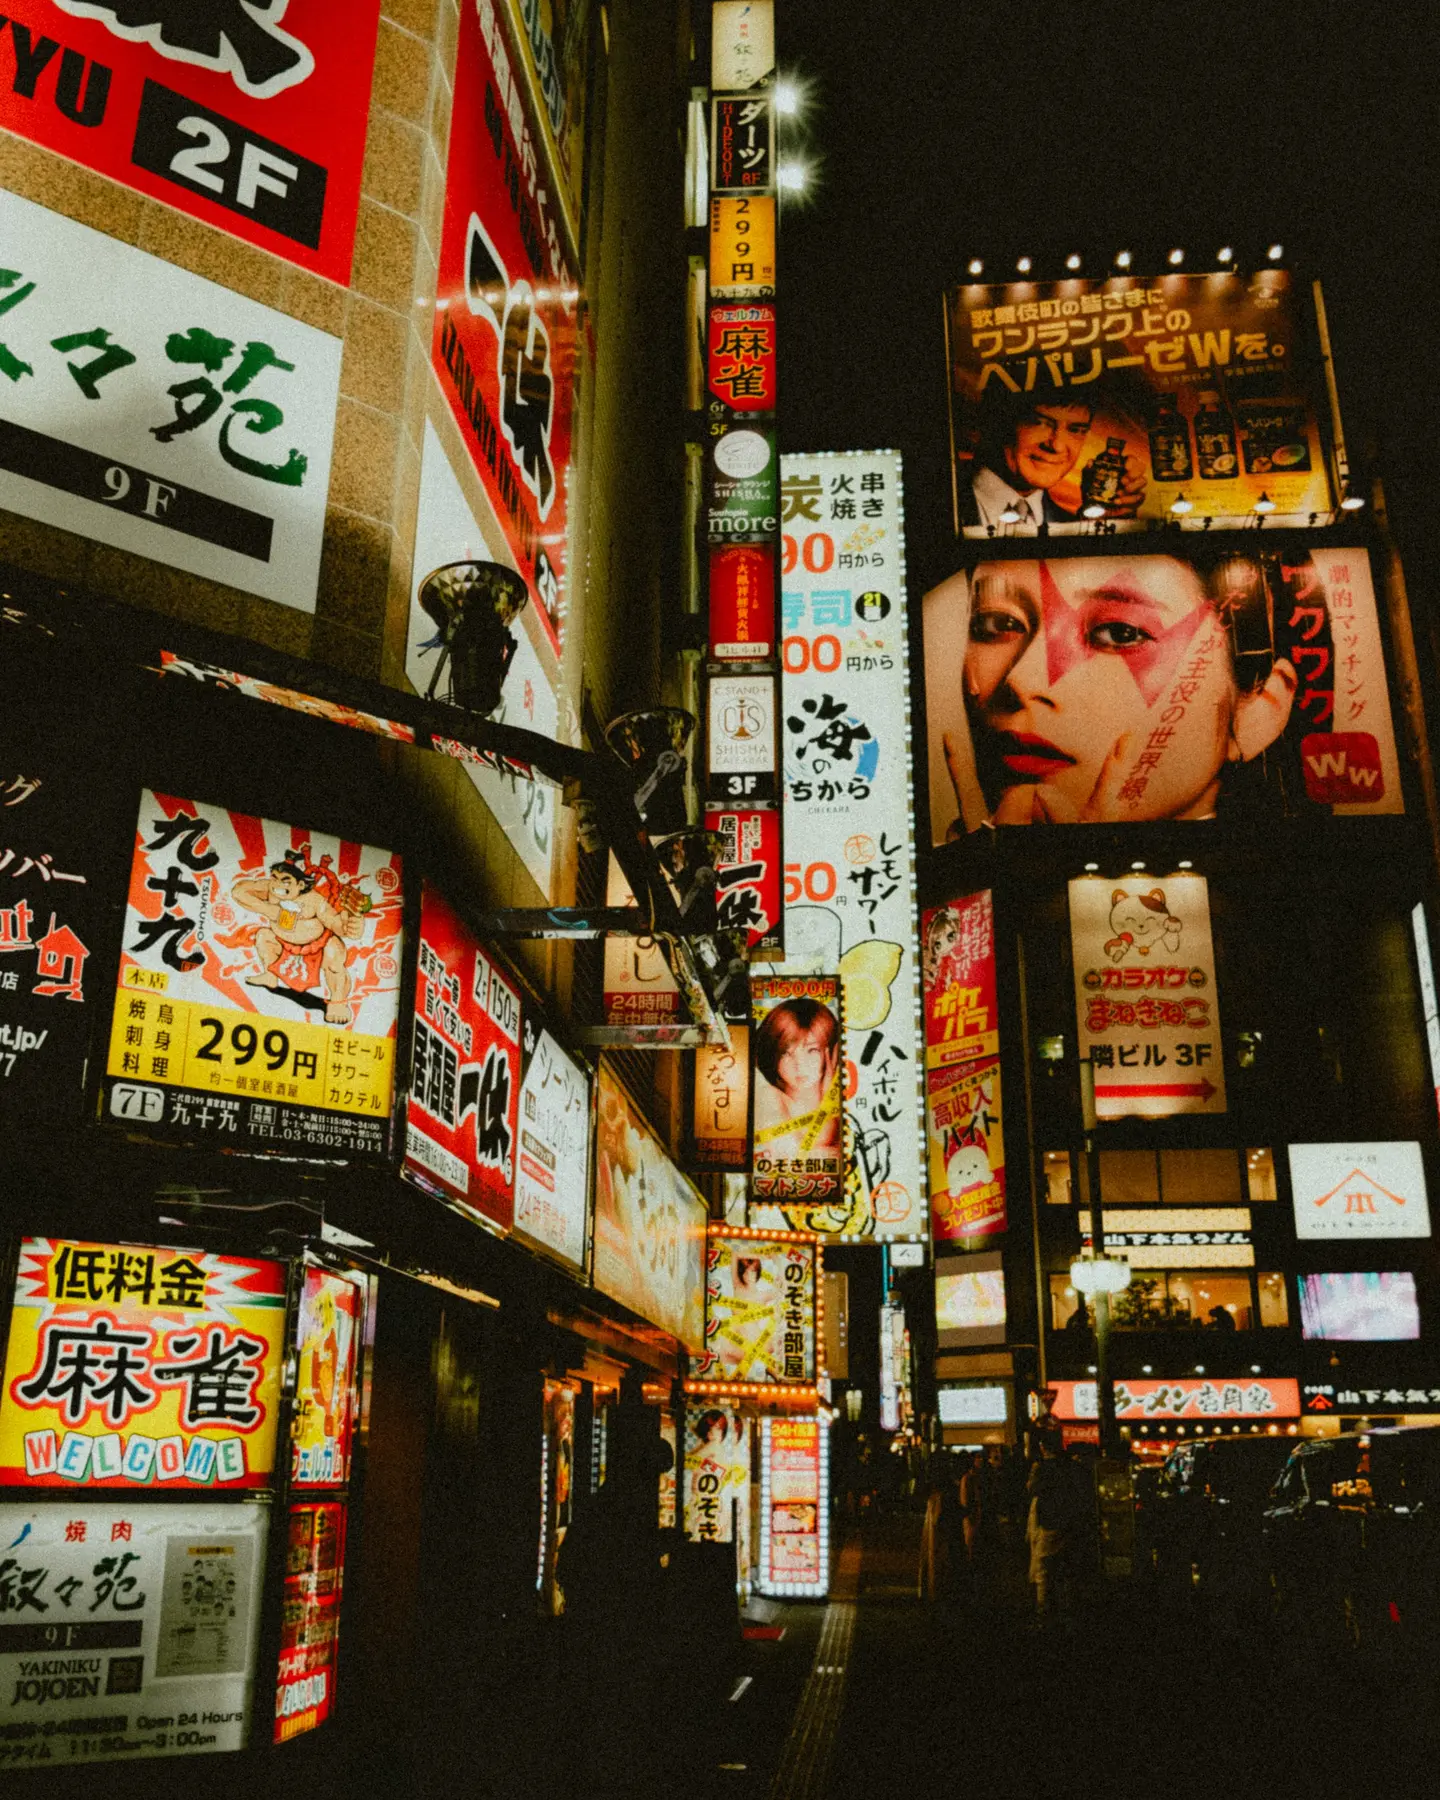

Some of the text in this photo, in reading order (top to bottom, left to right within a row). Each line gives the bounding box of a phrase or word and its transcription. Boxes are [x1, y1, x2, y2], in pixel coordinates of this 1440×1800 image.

[722, 103, 733, 187] HIDEOUT
[737, 102, 768, 169] ダーツ
[169, 114, 298, 209] 2F
[731, 199, 753, 281] 299円
[711, 308, 774, 321] ウェルカム
[971, 289, 1165, 329] 歌舞伎町の皆さまに
[971, 309, 1192, 359] ワンランク上の
[714, 325, 773, 399] 麻雀
[977, 329, 1286, 393] ヘパリーゼWを。
[710, 401, 727, 412] 6F
[710, 424, 728, 436] 5F
[102, 465, 177, 517] 9F
[708, 516, 777, 533] more
[1281, 564, 1334, 724] ワクワク
[1328, 564, 1367, 722] 劇的マッチング
[847, 655, 893, 671] 円から
[787, 693, 871, 760] 海
[716, 745, 768, 755] SHISHA
[812, 758, 832, 774] の
[0, 774, 42, 806] グ
[728, 776, 757, 795] 3F
[790, 777, 870, 801] ちから
[879, 832, 903, 900] レモン
[131, 812, 220, 971] 九十九
[847, 866, 880, 934] サワー
[196, 877, 211, 942] TSUKUMO
[761, 937, 779, 947] 2F
[127, 970, 166, 989] 本店
[1101, 967, 1189, 990] カラオケ
[128, 999, 175, 1025] 焼鳥
[611, 994, 674, 1010] 24時間
[1086, 995, 1210, 1034] まねきねこ
[0, 1023, 48, 1052] t.jp/
[125, 1025, 172, 1051] 刺身
[195, 1017, 318, 1080] 299円
[332, 1037, 385, 1060] 生ビール
[121, 1052, 169, 1077] 料理
[331, 1063, 370, 1080] サワー
[1089, 1044, 1212, 1069] 隣ビル 3F
[209, 1071, 300, 1099] 均一個室居酒屋
[412, 1017, 456, 1130] 居酒屋
[860, 1029, 909, 1123] ハイボール
[119, 1088, 161, 1120] 7F
[329, 1088, 382, 1111] カクテル
[460, 1046, 511, 1165] 一休
[933, 1084, 993, 1131] 高収入
[170, 1102, 238, 1132] 九十九
[943, 1110, 999, 1153] バイト
[247, 1123, 383, 1153] TEL.03-6302-1914
[1103, 1231, 1250, 1247] 山下本気うどん
[54, 1246, 207, 1308] 低料金
[20, 1321, 262, 1426] 麻雀
[26, 1435, 241, 1476] WELCOME
[64, 1519, 133, 1543] 焼肉
[0, 1551, 147, 1613] 叙々苑
[45, 1625, 81, 1647] 9F
[19, 1658, 102, 1677] YAKINIKU
[11, 1677, 101, 1706] JOJOEN
[136, 1714, 174, 1730] Open
[178, 1713, 199, 1726] 24
[202, 1711, 243, 1723] Hours
